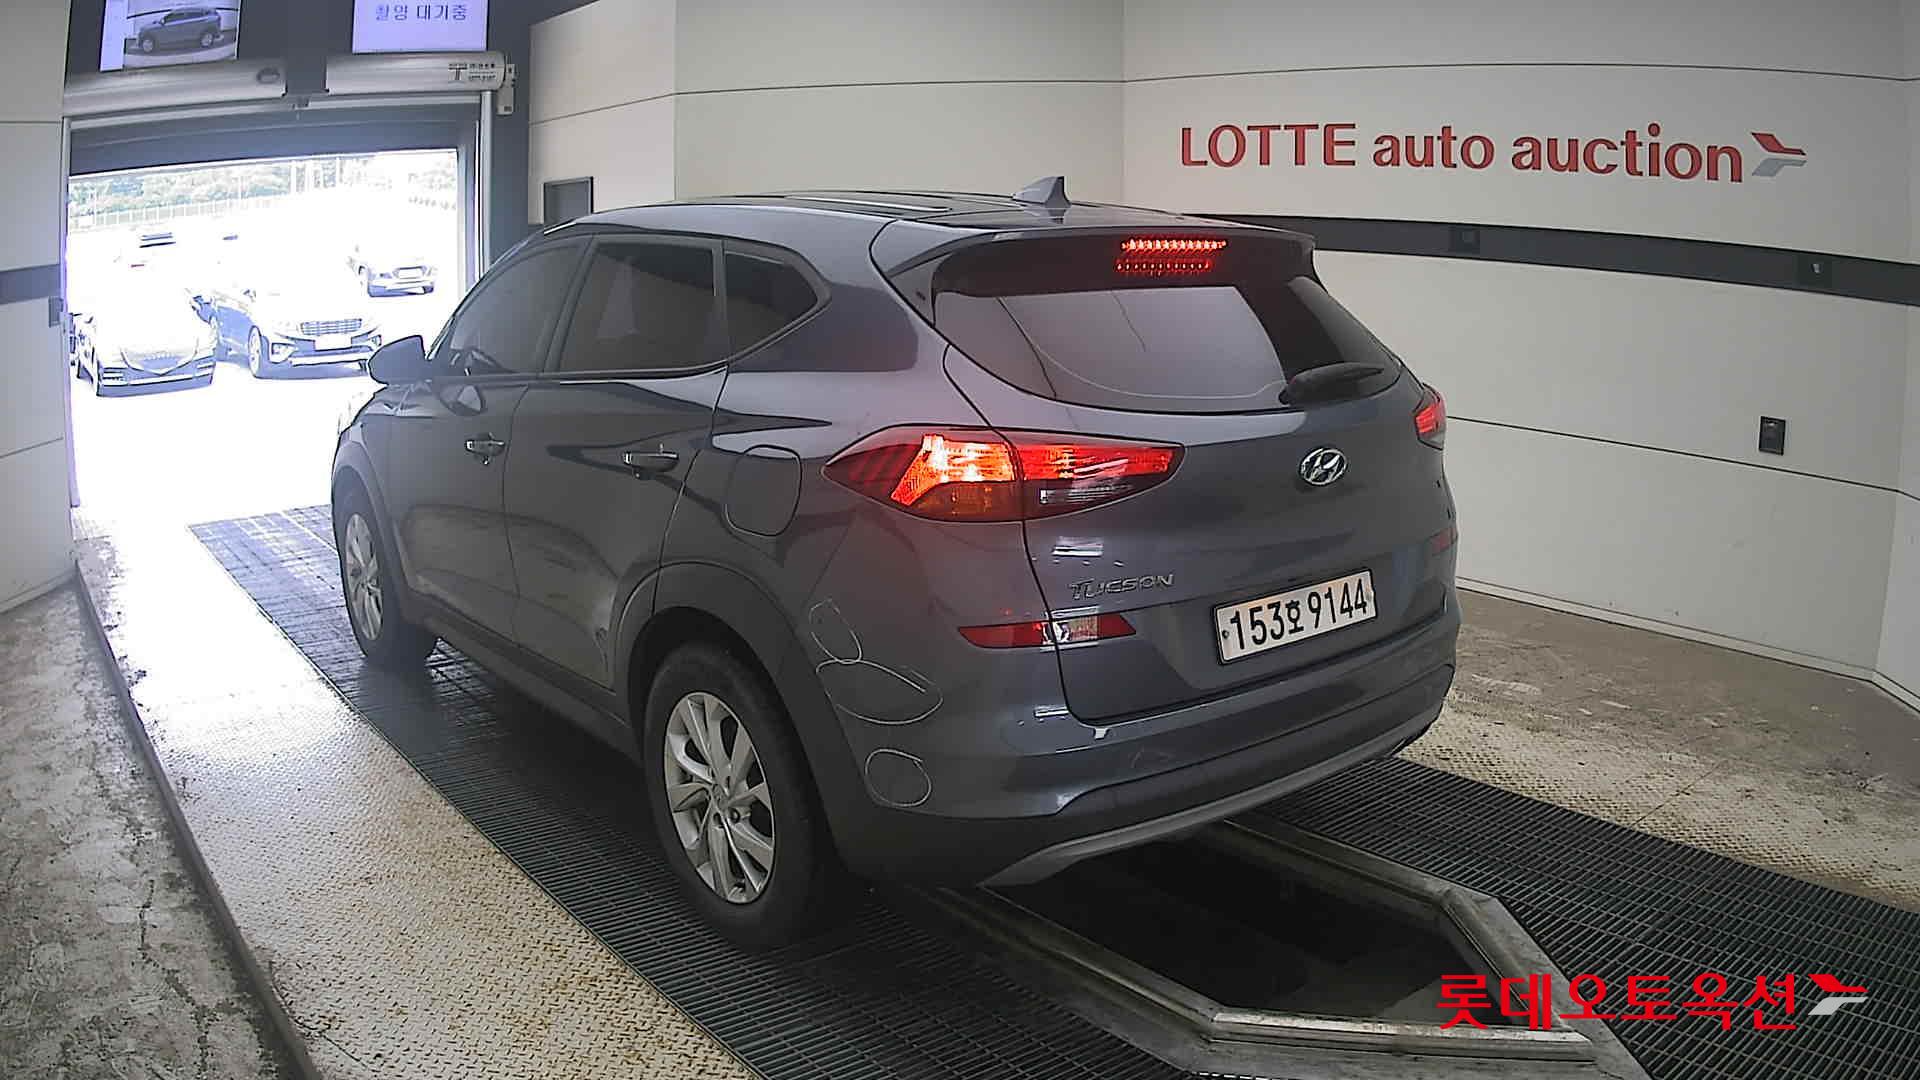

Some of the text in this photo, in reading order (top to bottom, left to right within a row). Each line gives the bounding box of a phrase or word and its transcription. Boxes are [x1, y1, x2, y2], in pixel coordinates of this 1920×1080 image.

[416, 3, 467, 21] 대기중
[1182, 122, 1744, 182] LOTTE auto auction
[1070, 574, 1175, 601] TUCSON
